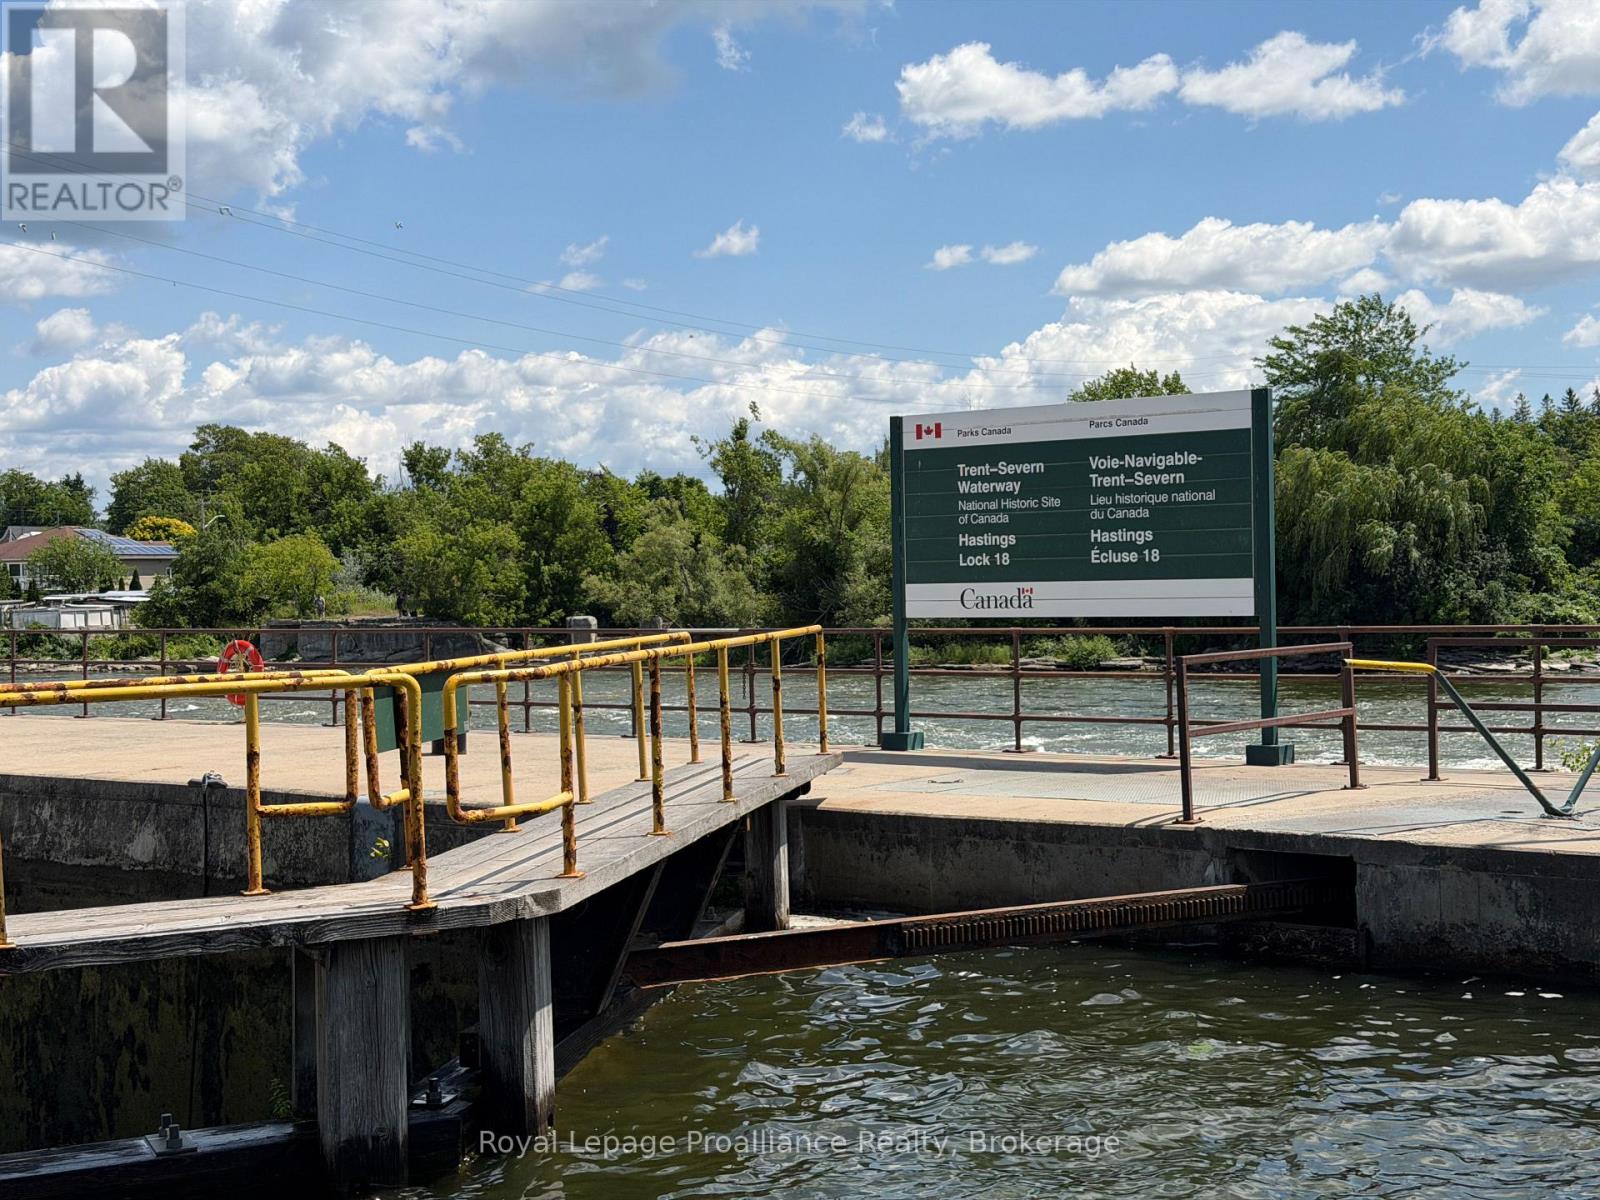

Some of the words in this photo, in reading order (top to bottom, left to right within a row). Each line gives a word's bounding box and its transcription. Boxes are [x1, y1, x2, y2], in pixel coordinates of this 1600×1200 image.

[1089, 418, 1113, 429] Parcs
[1117, 417, 1149, 428] Canada
[957, 428, 979, 438] Parks
[981, 426, 1012, 437] Canada
[1089, 451, 1203, 470] Voie-Navigable-
[957, 480, 1021, 495] Waterway
[958, 499, 998, 512] National
[1001, 497, 1040, 510] Historic
[1041, 496, 1061, 508] Site
[1090, 494, 1113, 506] Lieu
[1115, 491, 1169, 506] historique
[1171, 489, 1216, 502] national
[958, 513, 969, 525] of
[970, 511, 1010, 524] Canada
[1090, 508, 1104, 520] du
[1107, 507, 1150, 519] Canada
[959, 533, 1017, 549] Hastings
[1090, 528, 1154, 545] Hastings
[959, 553, 991, 567] Lock
[994, 552, 1010, 566] 18
[1091, 545, 1138, 564] Écluse
[1143, 548, 1160, 562] 18
[960, 587, 1034, 610] Canada
